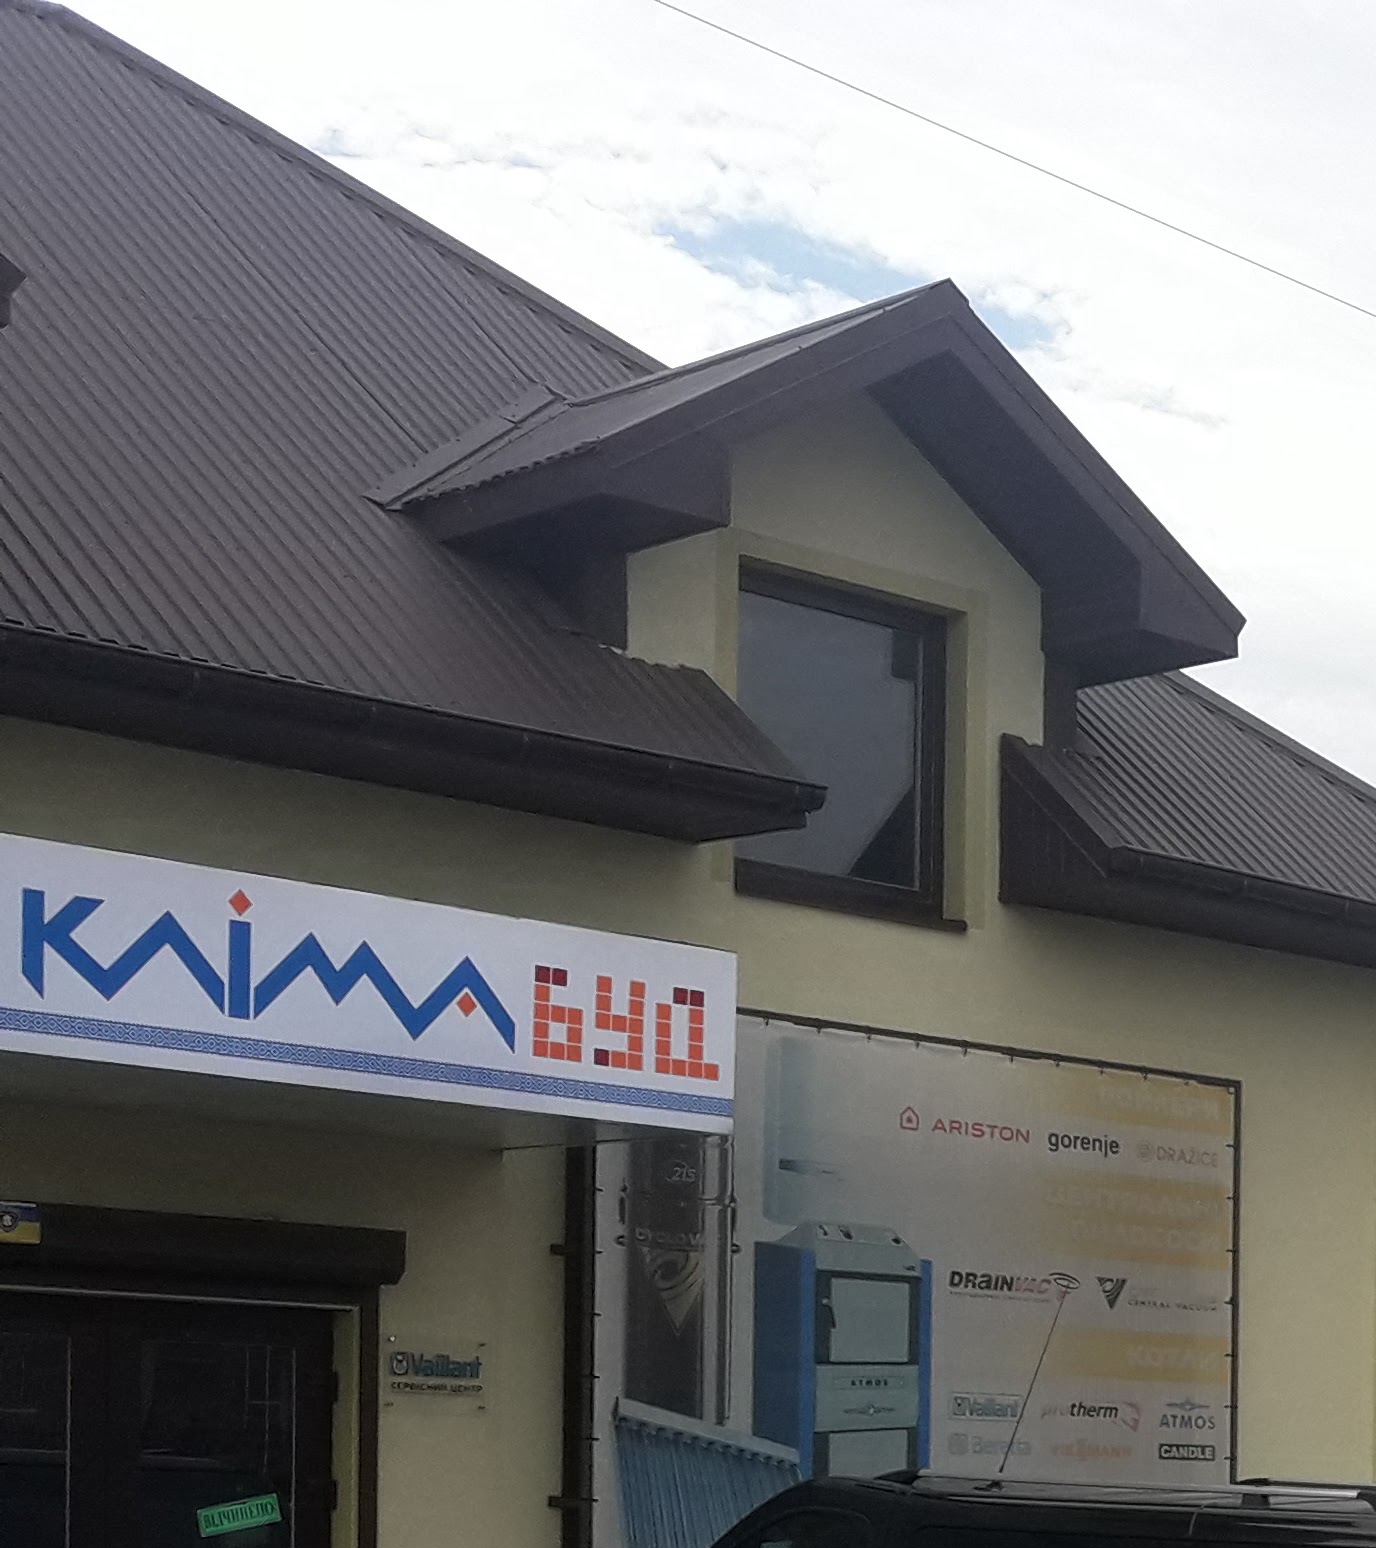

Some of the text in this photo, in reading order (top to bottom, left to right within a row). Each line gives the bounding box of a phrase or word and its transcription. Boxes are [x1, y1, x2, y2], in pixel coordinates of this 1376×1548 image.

[931, 1118, 1030, 1144] ARISTON
[1047, 1131, 1120, 1158] gorenje
[1159, 1415, 1216, 1431] ATMOS
[1161, 1446, 1214, 1460] CANDLE
